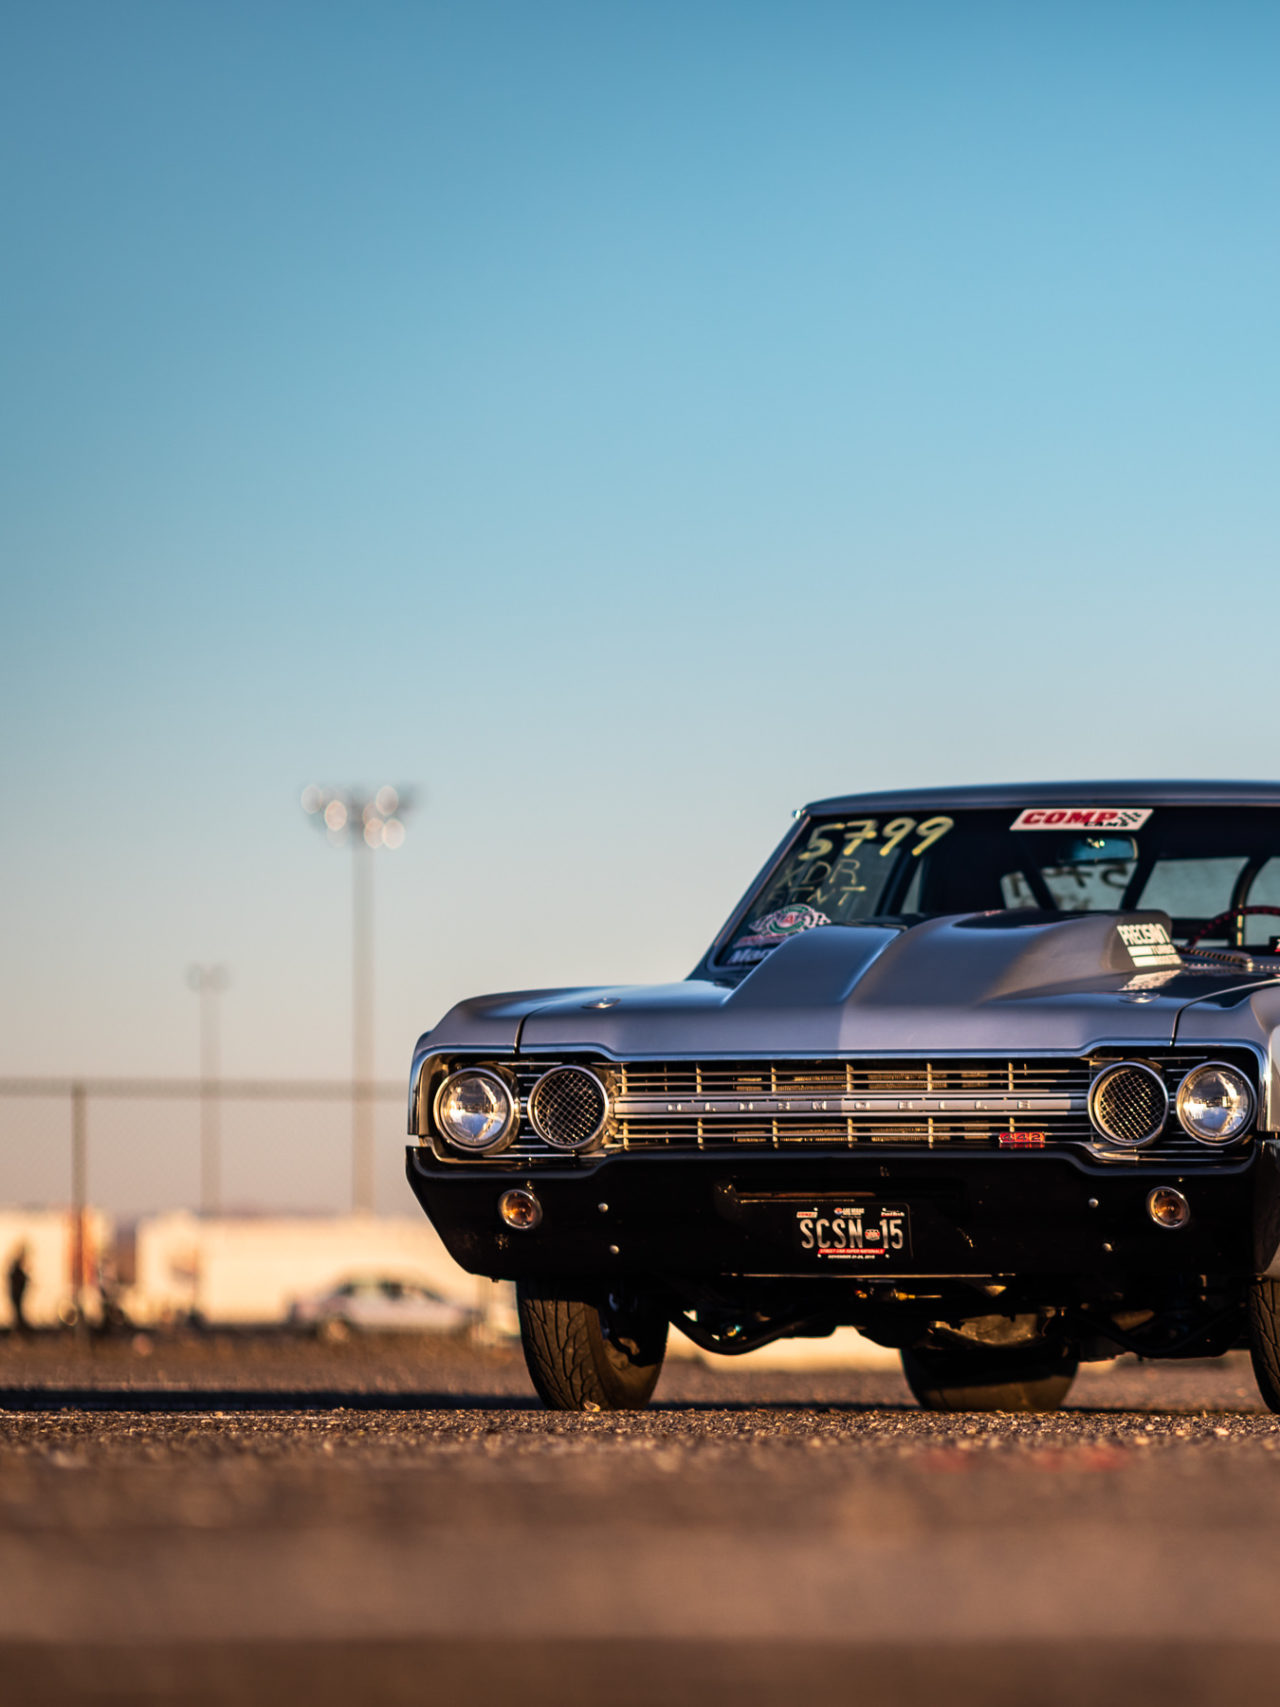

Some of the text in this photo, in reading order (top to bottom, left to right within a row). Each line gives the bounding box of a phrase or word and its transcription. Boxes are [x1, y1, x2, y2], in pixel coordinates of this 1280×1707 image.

[1021, 810, 1119, 825] COMP
[798, 815, 955, 860] 5799
[799, 1219, 863, 1249] SCSN
[879, 1219, 904, 1250] 15
